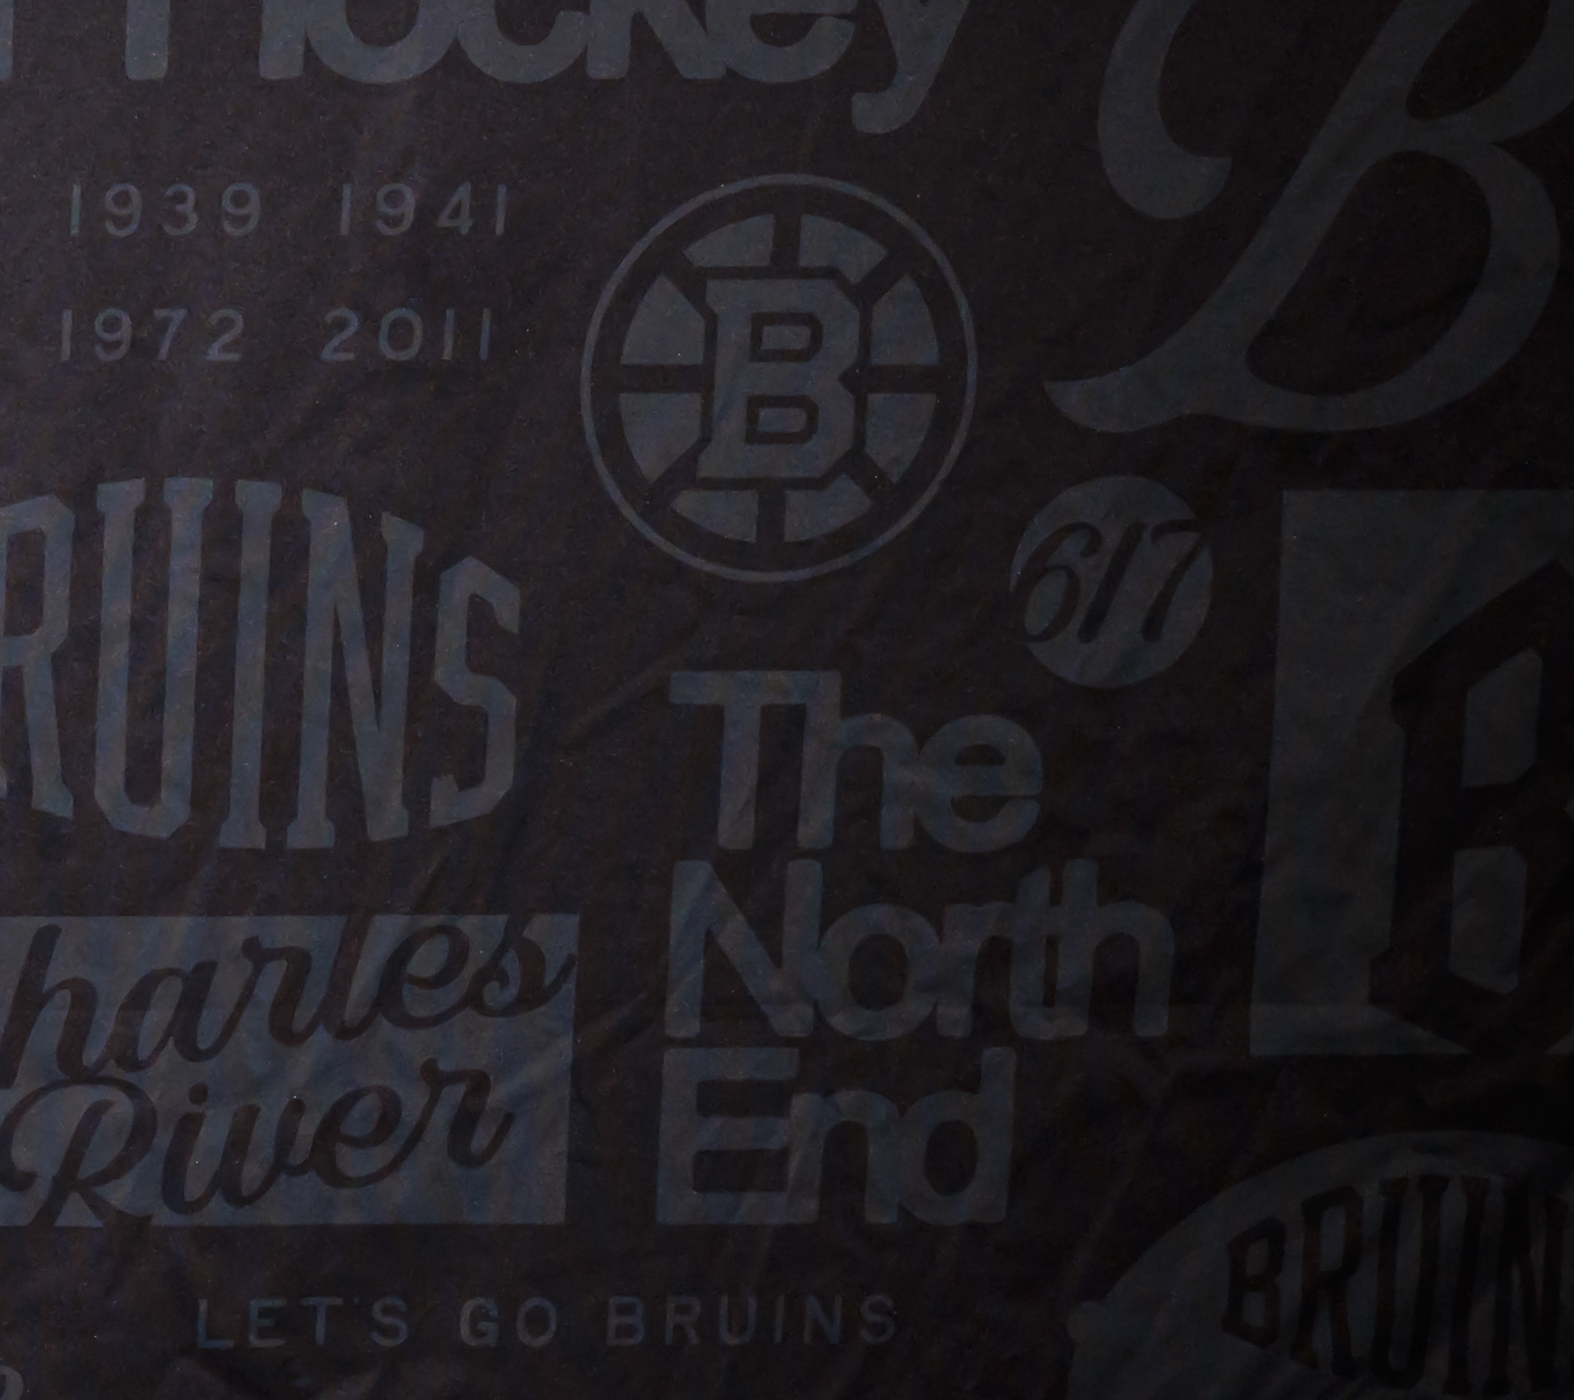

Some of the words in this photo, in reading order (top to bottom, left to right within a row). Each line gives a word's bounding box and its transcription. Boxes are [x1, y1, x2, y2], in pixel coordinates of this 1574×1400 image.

[68, 181, 264, 238] 1939
[339, 182, 509, 238] 1941
[58, 307, 246, 363] 1972
[320, 306, 493, 362] 2011
[1015, 516, 1217, 647] 617
[667, 669, 1044, 854] The
[663, 858, 1176, 1041] North
[656, 1046, 1019, 1226] End
[196, 1295, 411, 1351] LET'S
[458, 1295, 560, 1348] GO
[605, 1293, 900, 1349] BRUINS
[1222, 1173, 1574, 1397] BRUIN
